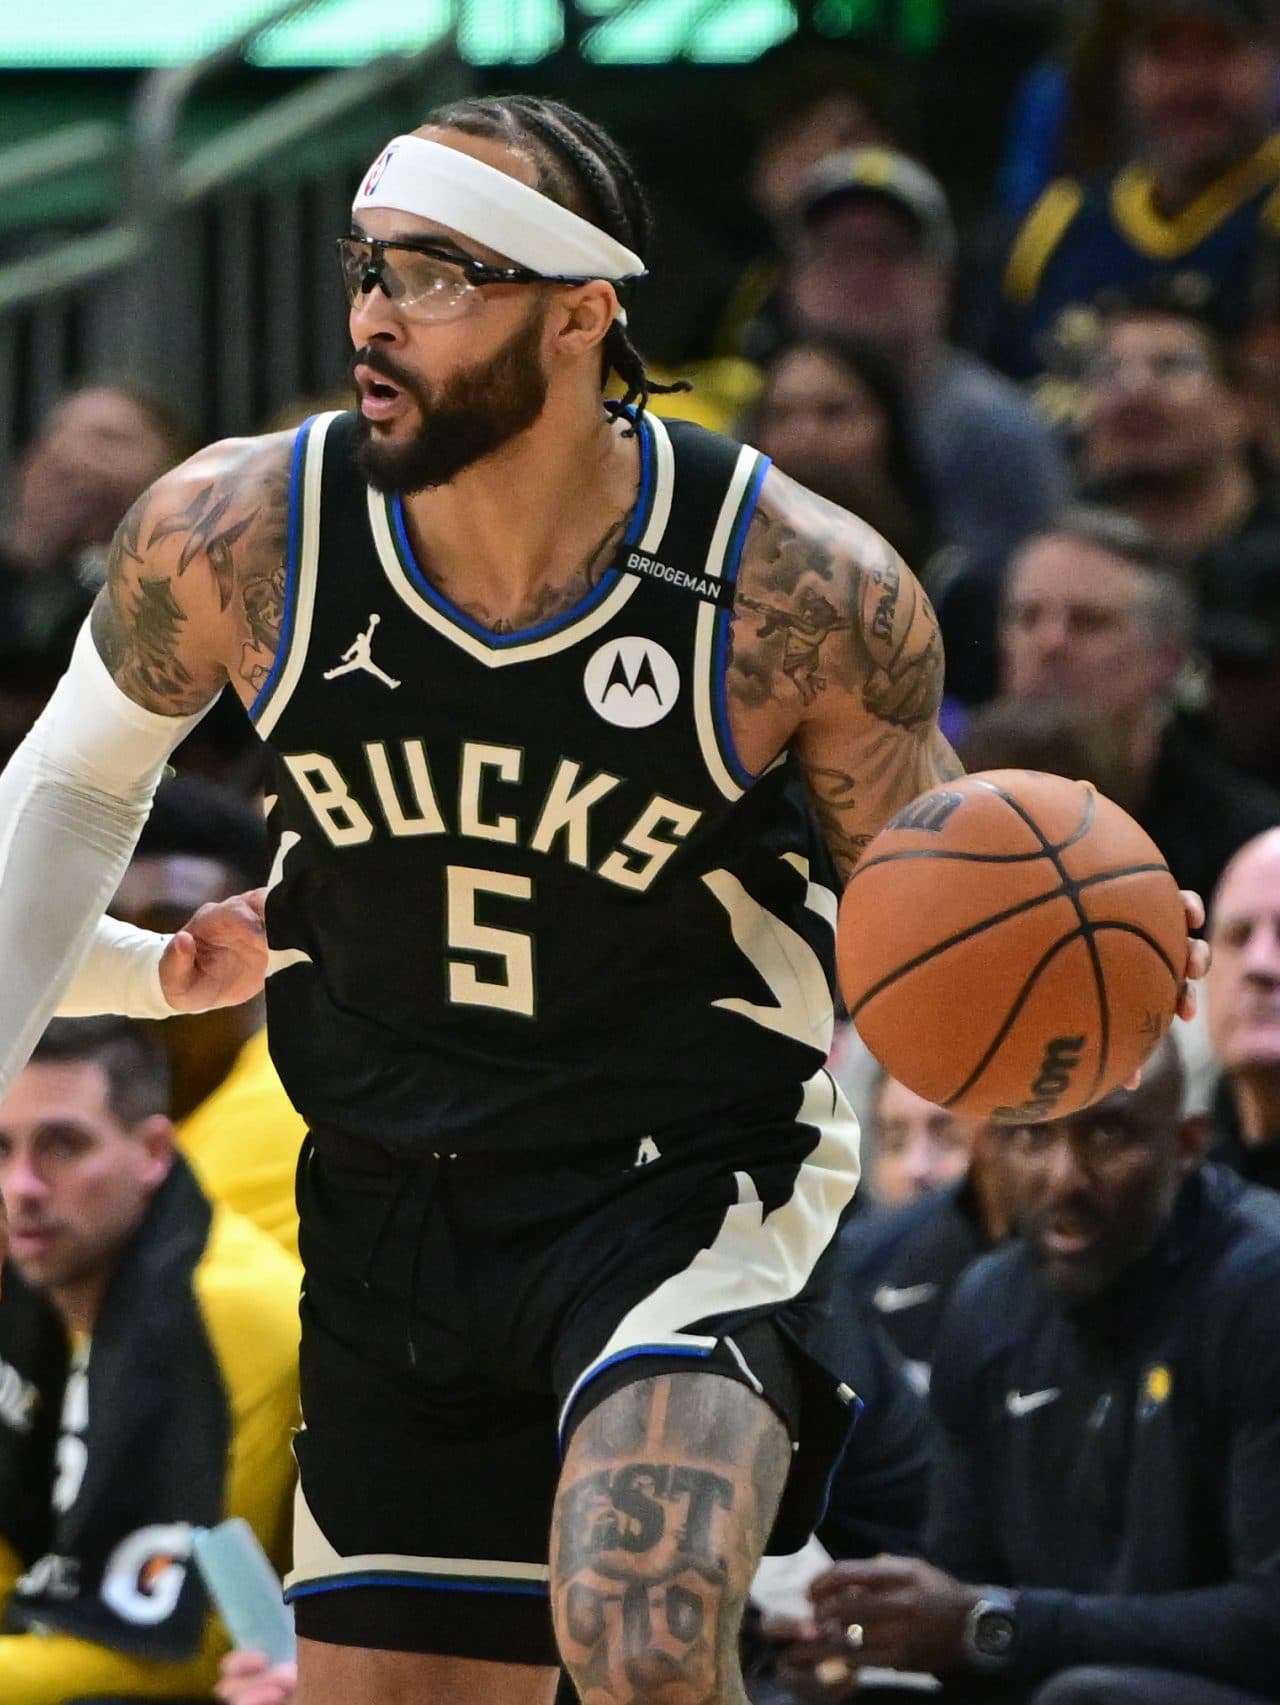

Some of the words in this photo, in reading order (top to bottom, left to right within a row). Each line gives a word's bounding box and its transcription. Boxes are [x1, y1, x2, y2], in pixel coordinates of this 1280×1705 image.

[627, 553, 721, 599] BRIDGEMAN
[282, 738, 703, 892] BUCKS
[446, 864, 536, 1017] 5
